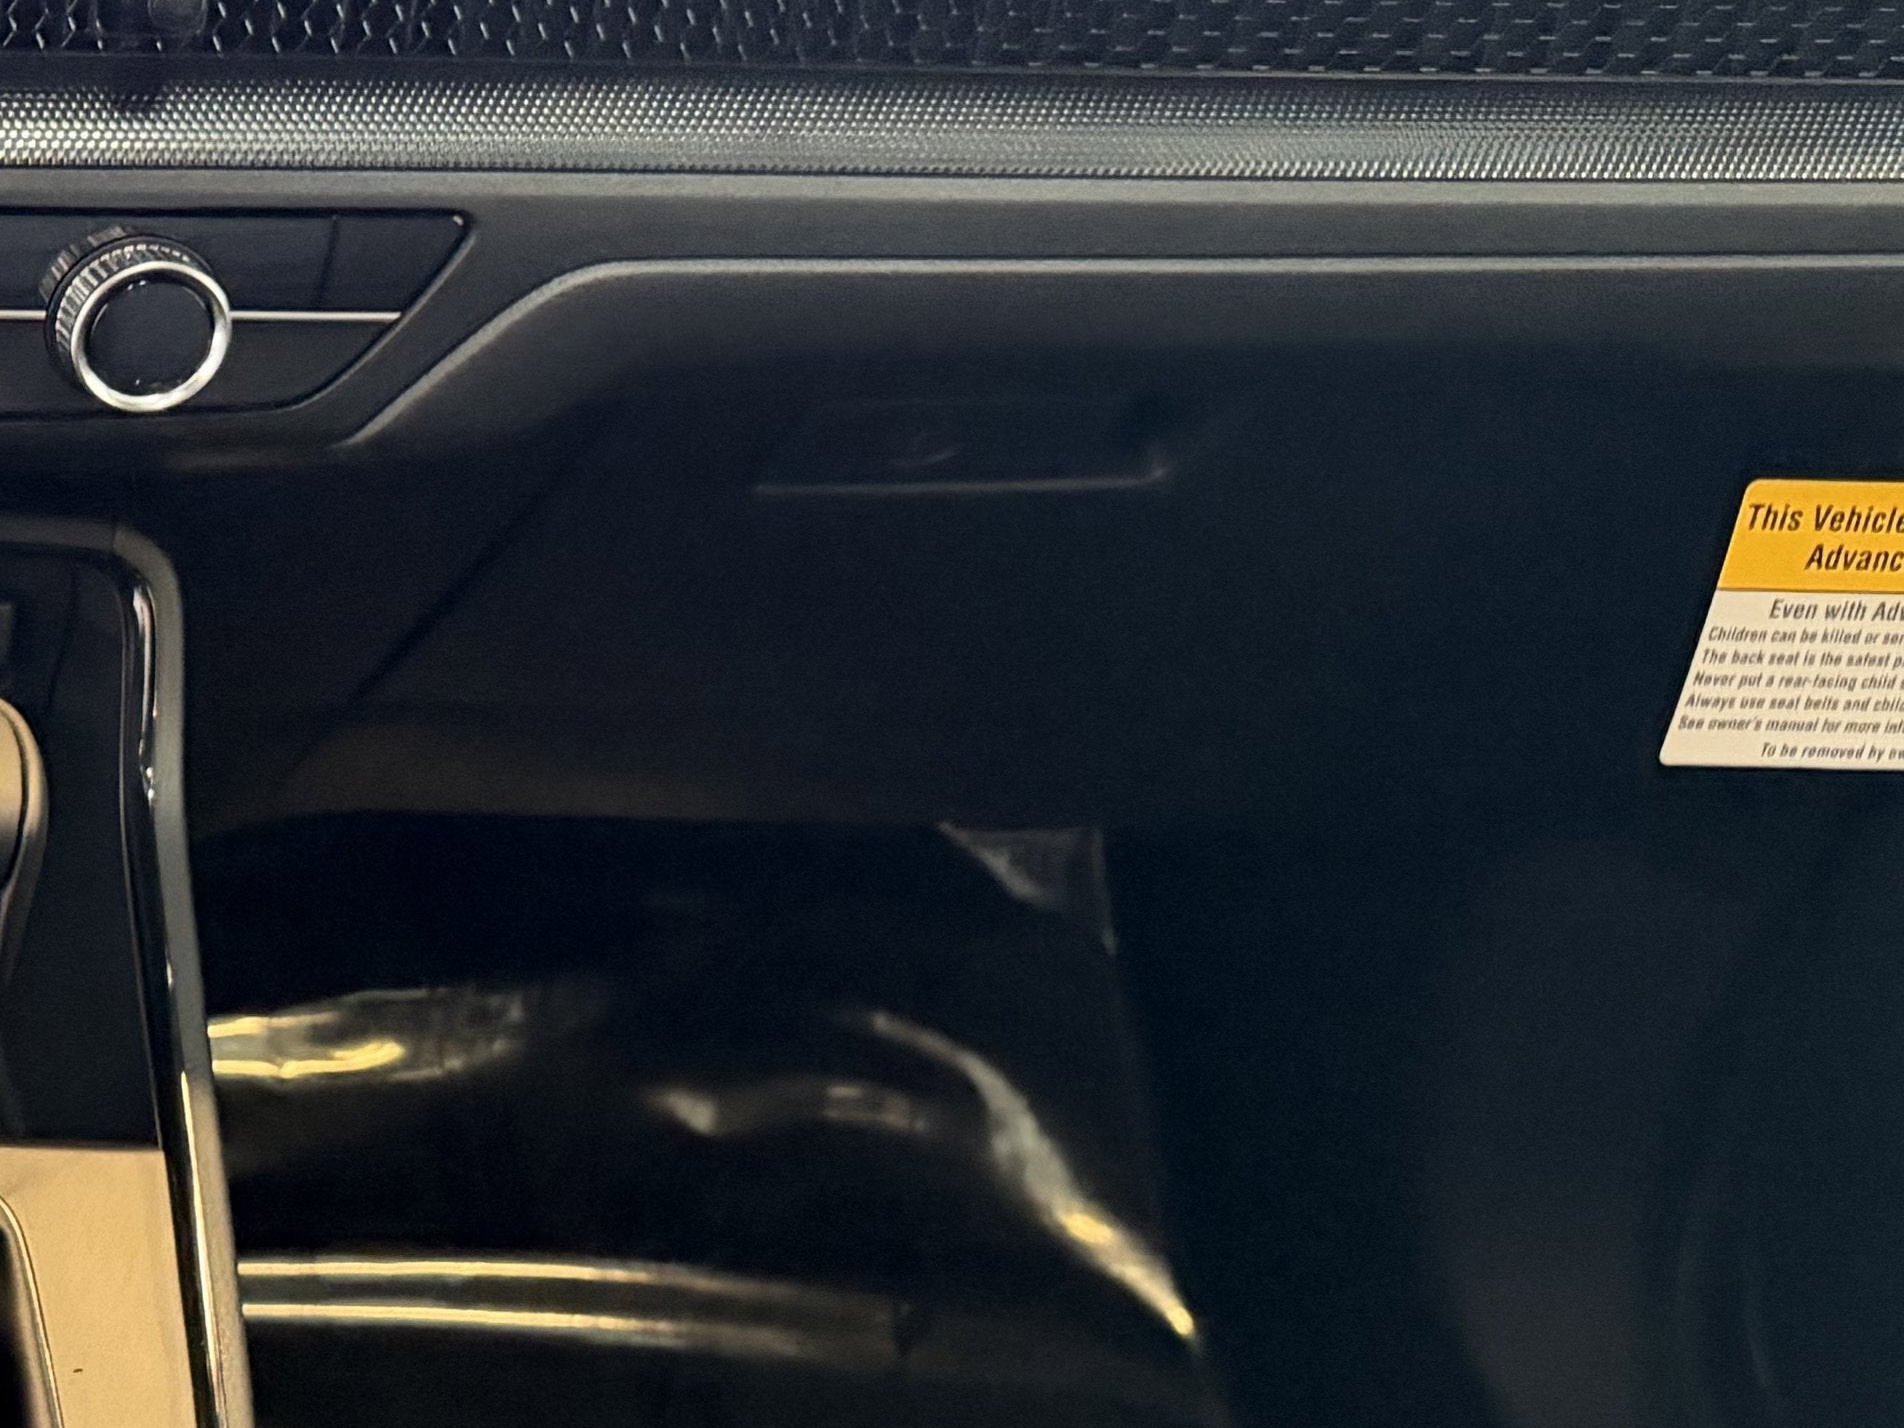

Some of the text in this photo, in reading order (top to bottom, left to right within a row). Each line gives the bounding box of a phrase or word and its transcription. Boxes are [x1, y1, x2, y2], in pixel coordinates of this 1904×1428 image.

[1748, 503, 1804, 532] This
[1769, 598, 1818, 620] Even
[1824, 599, 1867, 621] with
[1708, 625, 1768, 643] Children
[1771, 630, 1797, 643] can
[1799, 627, 1818, 644] be
[1820, 627, 1863, 645] killed
[1864, 632, 1880, 645] or
[1702, 648, 1728, 665] The
[1731, 648, 1766, 665] back
[1768, 650, 1801, 666] seat
[1802, 649, 1816, 666] is
[1819, 651, 1843, 667] the
[1846, 651, 1891, 668] safest
[1693, 669, 1736, 687] Never
[1737, 672, 1763, 690] put
[1778, 673, 1858, 692] rear-facing
[1861, 673, 1898, 690] child
[1685, 693, 1737, 712] Always
[1739, 696, 1766, 709] use
[1768, 695, 1802, 710] seat
[1803, 695, 1840, 710] belts
[1842, 695, 1872, 712] and
[1678, 714, 1706, 730] See
[1707, 715, 1763, 731] owner's
[1765, 717, 1820, 732] manual
[1820, 717, 1842, 732] for
[1843, 721, 1881, 733] more
[1761, 741, 1777, 757] To
[1779, 743, 1798, 758] be
[1800, 742, 1866, 760] removed
[1867, 744, 1886, 763] by
